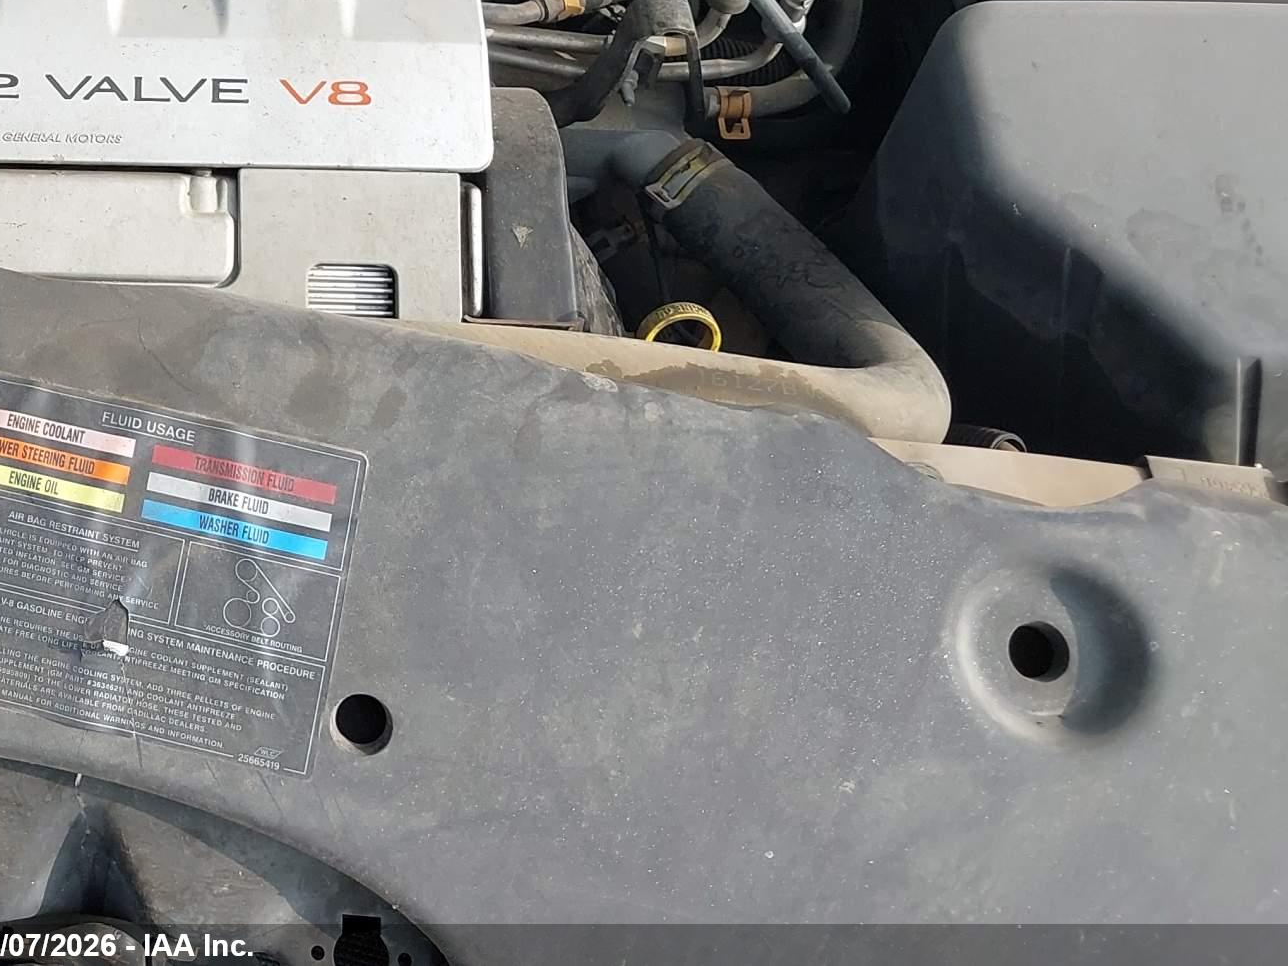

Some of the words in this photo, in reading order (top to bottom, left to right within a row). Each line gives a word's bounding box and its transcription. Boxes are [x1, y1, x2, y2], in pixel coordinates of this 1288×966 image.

[44, 74, 249, 104] VALVE
[279, 79, 372, 105] V8
[2, 132, 63, 143] GENERAL
[66, 133, 122, 144] MOTORS
[6, 414, 41, 433] ENGINE
[42, 422, 85, 444] COOLANT
[102, 411, 142, 430] FLUID
[146, 421, 195, 442] USAGE
[21, 445, 66, 467] STEERING
[68, 456, 95, 474] FLUID
[194, 456, 265, 485] TRANSMISSION
[266, 473, 295, 492] FLUID
[8, 470, 42, 490] ENGINE
[44, 479, 60, 494] OIL
[207, 488, 239, 507] BRAKE
[241, 495, 269, 514] FLUID
[8, 510, 24, 521] AIR
[26, 515, 46, 526] BAG
[48, 520, 99, 538] RESTRAINT
[102, 533, 140, 548] SYSTEM
[198, 515, 240, 537] WASHER
[241, 525, 269, 544] FLUID
[38, 536, 76, 551] EQUIPPED
[78, 546, 99, 556] WITH
[64, 552, 84, 562] HELP
[87, 557, 121, 571] PREVENT
[21, 561, 69, 578] DIAGNOSTIC
[89, 578, 124, 592] SERVICE
[21, 571, 52, 584] BEFORE
[54, 579, 105, 596] PERFORMING
[125, 596, 158, 609] SERVICE
[92, 569, 127, 582] SERVICE
[0, 597, 14, 607] V-8
[16, 601, 62, 619] GASOLINE
[146, 632, 184, 648] SYSTEM
[186, 641, 254, 665] MAINTENANCE
[256, 658, 315, 680] PROCEDURE
[251, 635, 268, 645] BELT
[270, 639, 302, 653] ROUTING
[13, 619, 52, 634] REQUIRES
[150, 652, 188, 666] COOLANT
[191, 662, 243, 680] SUPPLEMENT
[246, 675, 288, 691] (SEALANT)
[14, 629, 34, 639] FREE
[37, 635, 58, 645] LONG
[170, 667, 205, 681] MEETING
[223, 679, 284, 700] SPECIFICATION
[41, 657, 70, 670] ENGINE
[72, 664, 108, 679] COOLING
[166, 687, 192, 699] THREE
[194, 694, 228, 708] PELLETS
[244, 706, 276, 720] ENGINE
[63, 682, 91, 695] LOWER
[93, 689, 133, 705] RADIATOR
[164, 706, 189, 718] THESE
[192, 713, 222, 726] TESTED
[64, 672, 83, 683] PART
[146, 692, 184, 707] COOLANT
[186, 702, 235, 720] ANTIFREEZE
[1, 688, 33, 702] MANUAL
[54, 701, 100, 718] ADDITIONAL
[102, 713, 145, 729] WARNINGS
[57, 690, 99, 706] AVAILABLE
[101, 701, 124, 712] FROM
[126, 707, 166, 722] CADILLAC
[237, 753, 280, 770] 25665419
